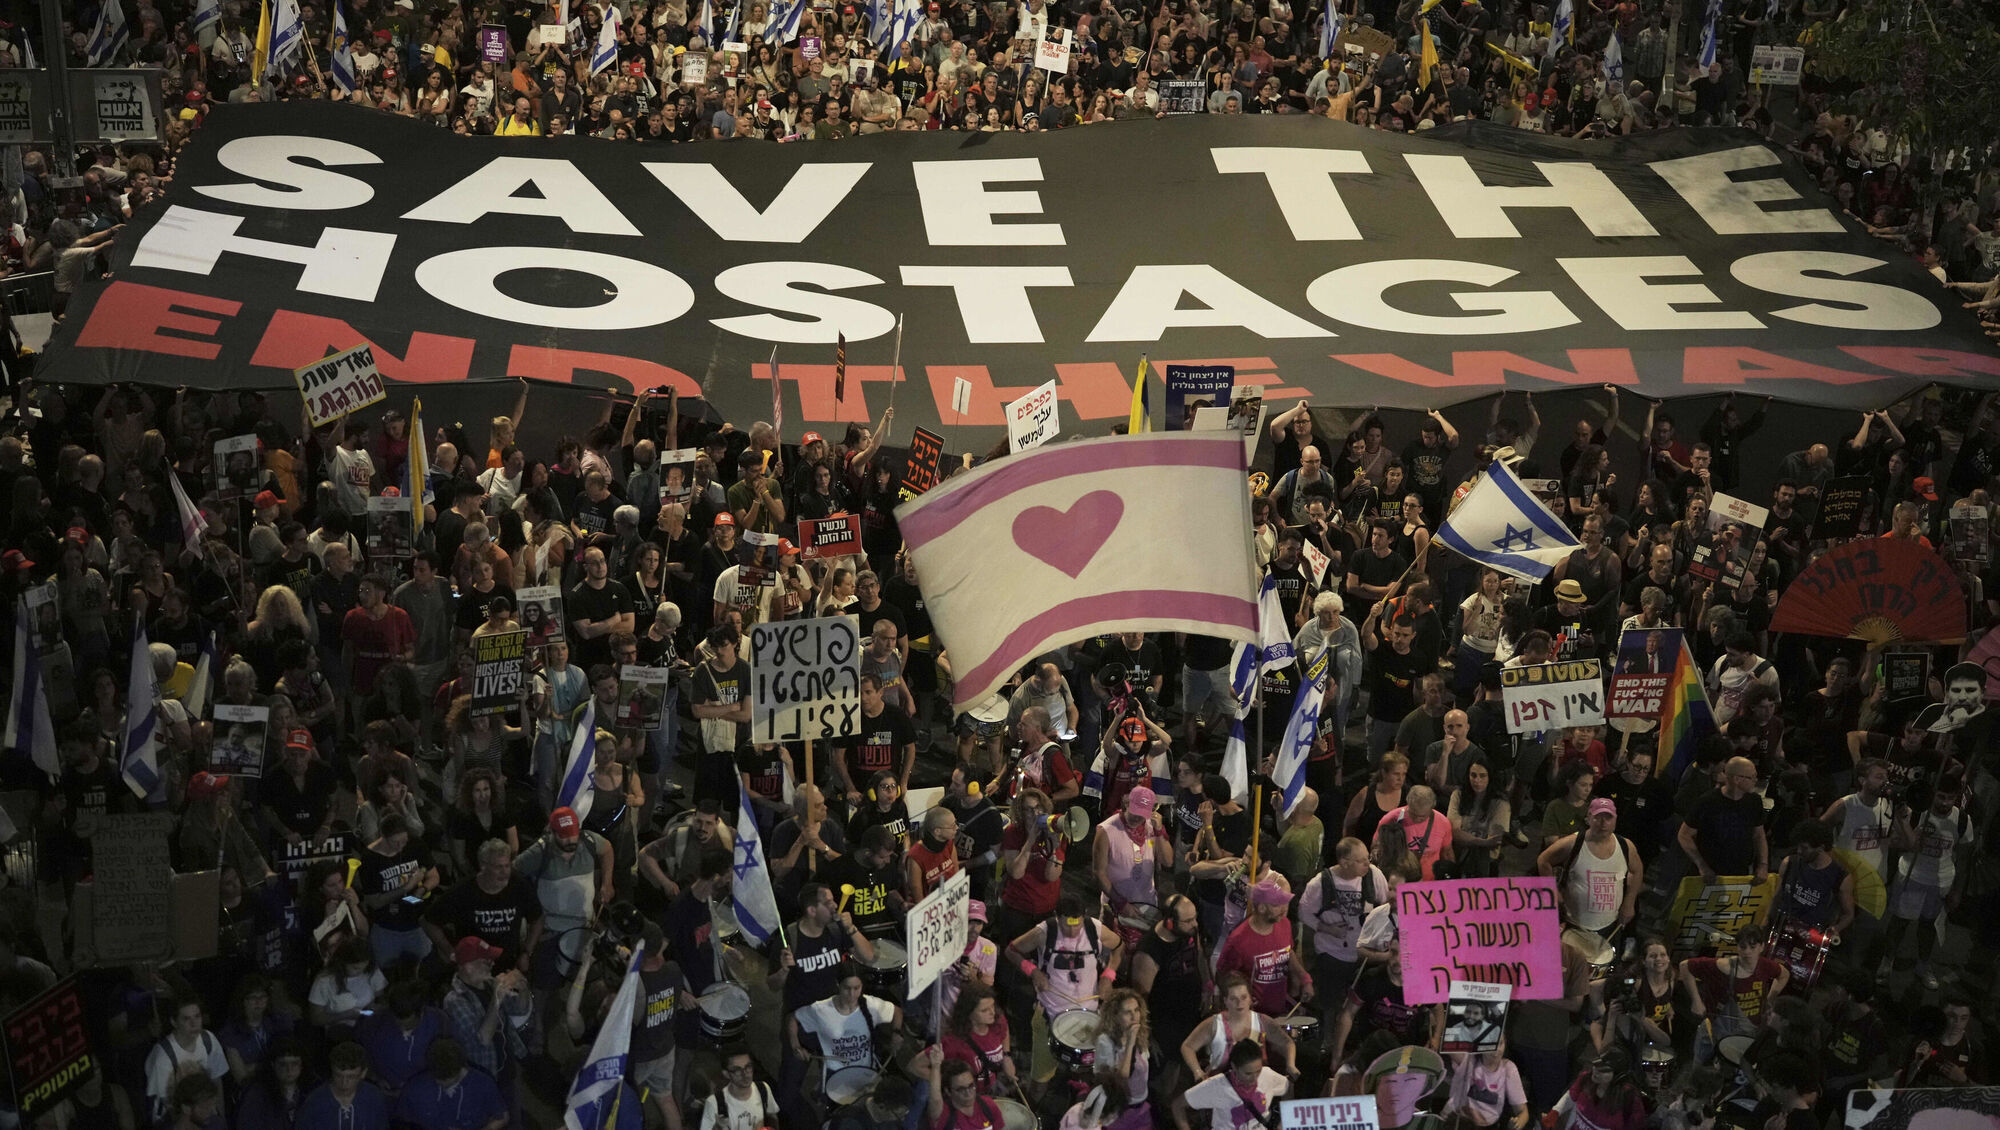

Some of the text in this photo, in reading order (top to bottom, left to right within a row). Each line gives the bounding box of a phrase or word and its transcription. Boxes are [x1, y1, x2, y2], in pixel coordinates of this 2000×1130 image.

[0, 102, 29, 117] אש
[99, 101, 142, 118] אשם
[101, 119, 143, 131] במחדל
[191, 135, 1848, 245] SAVE THE
[130, 204, 1942, 344] HOSTAGES
[75, 281, 2000, 425] END THE WAR
[303, 346, 375, 393] האדישות
[1171, 371, 1229, 381] אין ניצחון בלי
[307, 371, 385, 421] הורגת!
[1171, 380, 1229, 392] סגן הדר גולדין
[1017, 390, 1053, 420] כפכפים
[1018, 423, 1045, 450] שמשון
[911, 435, 939, 468] ביבי
[906, 459, 932, 491] בוגד
[1826, 489, 1862, 501] ממשלת
[815, 530, 854, 547] זה הזמן.
[819, 520, 848, 533] עכשיו
[479, 646, 502, 661] YOUR
[480, 635, 496, 650] THE
[515, 631, 526, 644] OF
[752, 622, 855, 667] פושעים
[473, 671, 523, 699] LIVES!
[759, 666, 860, 704] השתלטו
[1502, 660, 1600, 688] לחטופים
[1616, 677, 1667, 689] END THIS
[769, 702, 860, 740] עלינו
[1511, 692, 1598, 727] אין זמן
[1612, 699, 1661, 715] WAR
[854, 883, 888, 903] SEAL
[854, 898, 887, 916] DEAL
[1402, 880, 1556, 916] במלחמת נצח
[474, 907, 517, 925] שבעה
[1431, 919, 1532, 956] תעשה לך
[796, 947, 842, 974] חופשי
[10, 990, 83, 1045] ביבי
[15, 1025, 88, 1079] בוגד
[21, 1054, 92, 1111] בחטופים
[1294, 1102, 1363, 1125] ביבי וזיני
